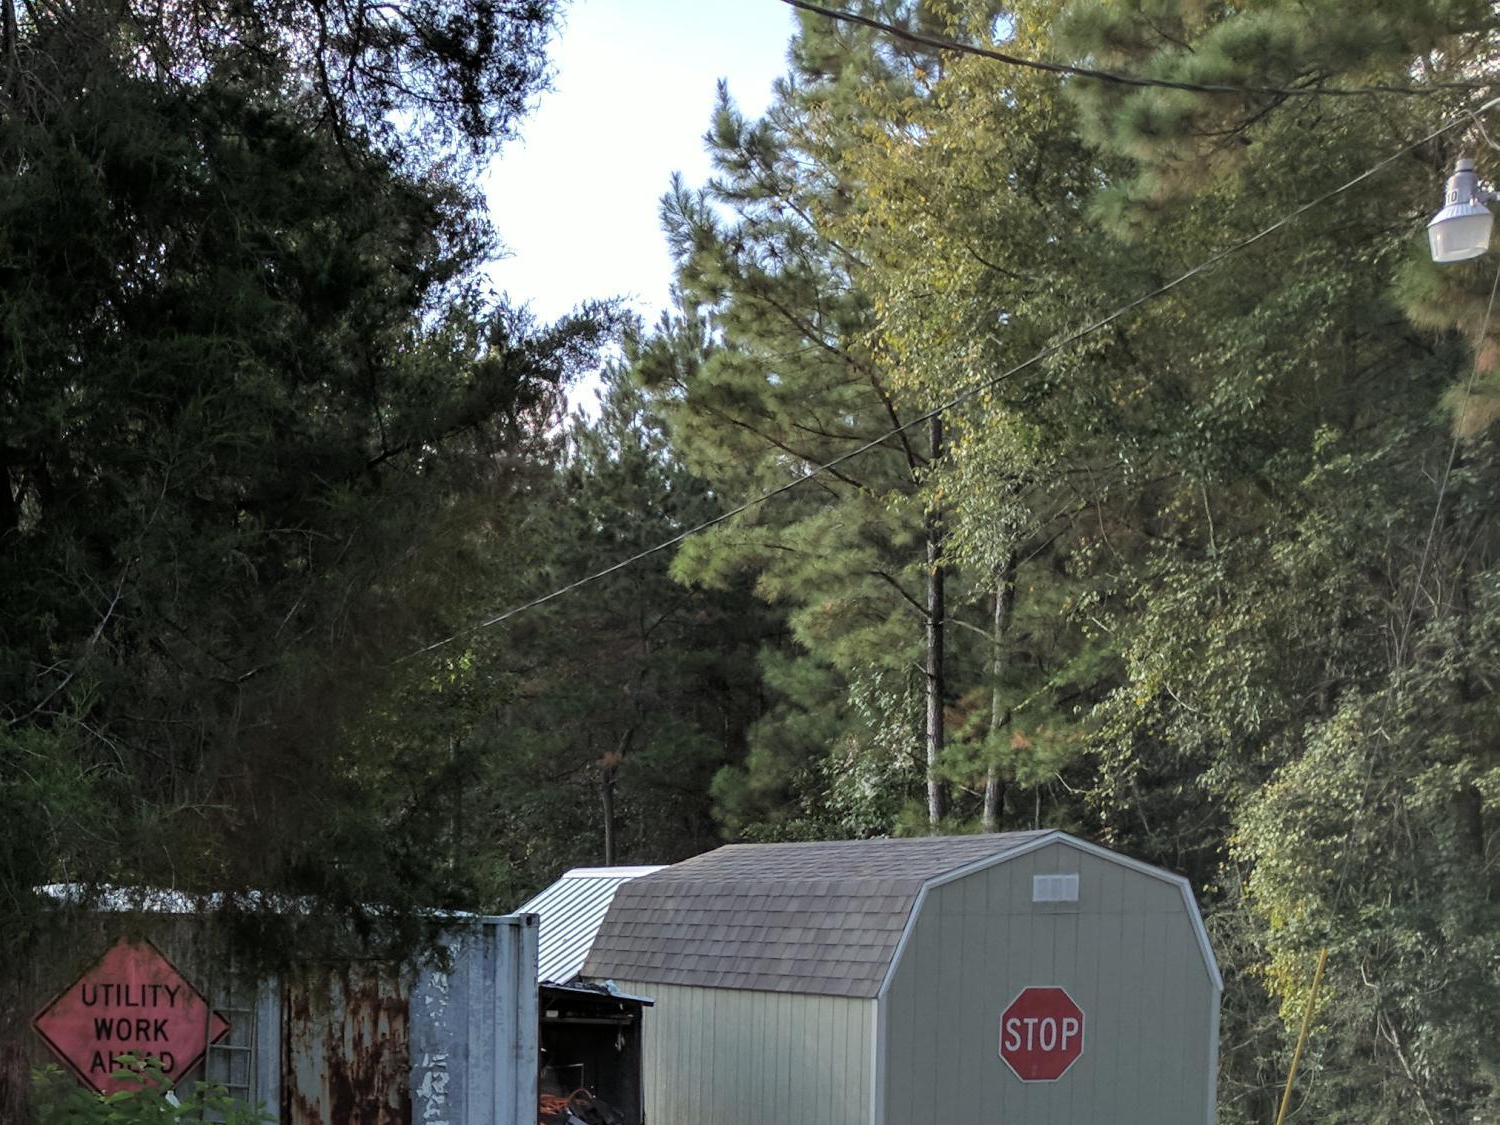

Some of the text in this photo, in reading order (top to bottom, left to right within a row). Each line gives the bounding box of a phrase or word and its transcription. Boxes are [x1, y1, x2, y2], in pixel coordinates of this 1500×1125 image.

[81, 983, 181, 1008] UTILITY
[94, 1018, 169, 1042] WORK
[1004, 1016, 1079, 1052] STOP
